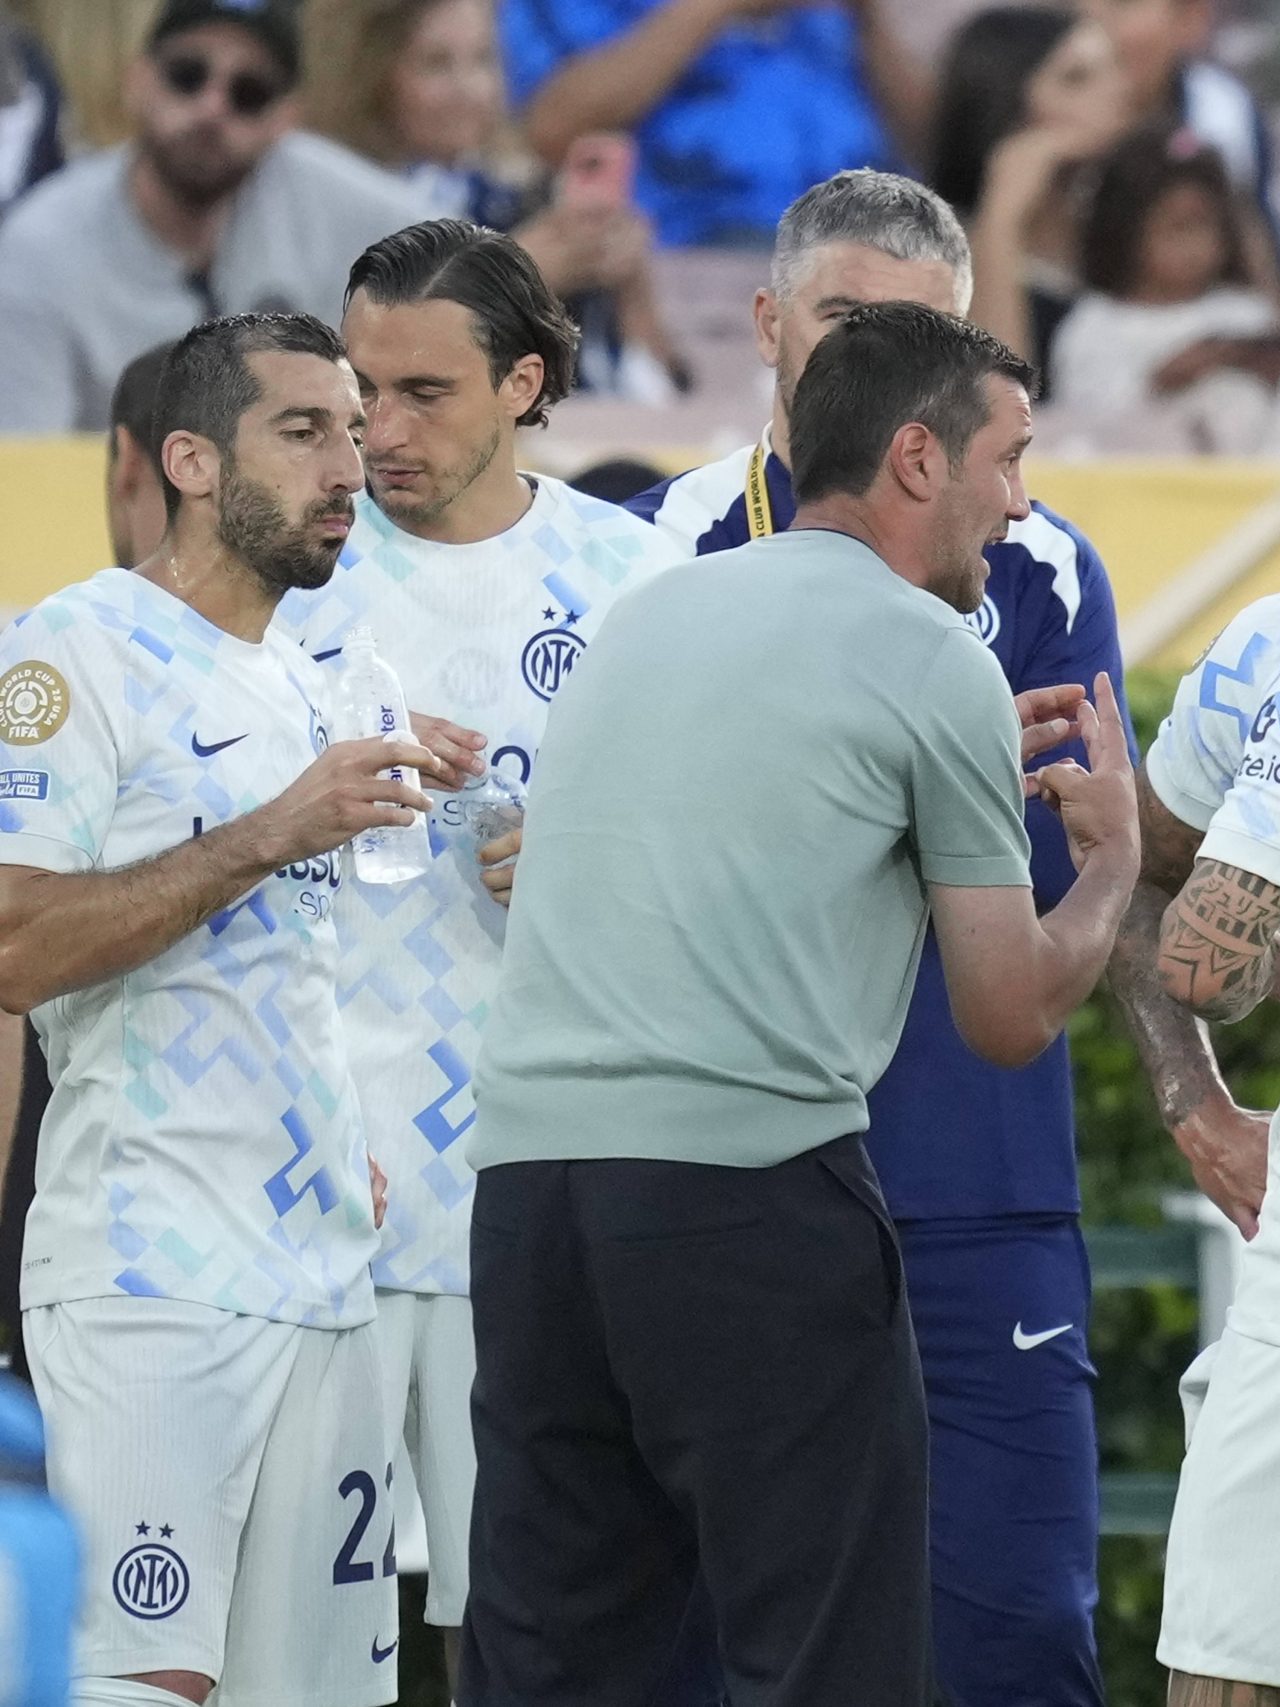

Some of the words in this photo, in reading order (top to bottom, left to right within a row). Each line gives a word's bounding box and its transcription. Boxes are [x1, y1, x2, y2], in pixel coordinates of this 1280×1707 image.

[0, 669, 32, 697] WORLD
[35, 671, 56, 686] CUP
[43, 705, 62, 726] USA
[8, 725, 40, 739] FIFA
